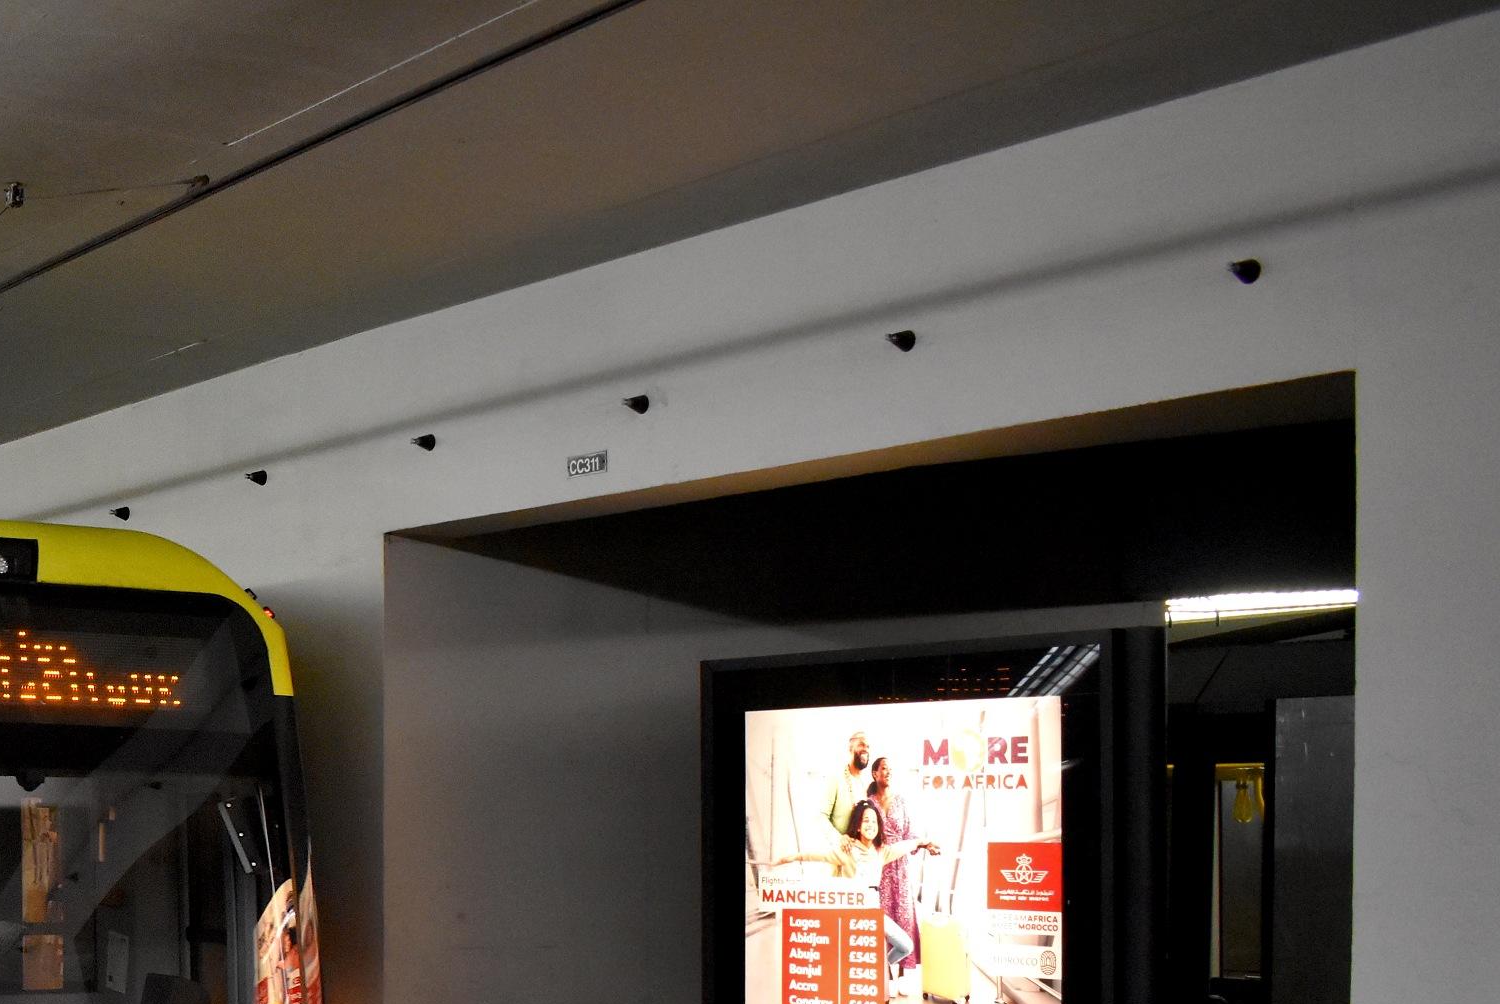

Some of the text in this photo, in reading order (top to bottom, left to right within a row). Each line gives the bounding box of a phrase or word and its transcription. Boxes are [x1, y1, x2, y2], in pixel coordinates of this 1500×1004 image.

[569, 456, 600, 475] CC311
[922, 773, 1029, 790] FOR AFRICA
[762, 889, 865, 906] MANCHESTER
[789, 916, 878, 932] Lagos £495
[789, 931, 878, 948] Abidjan £495
[789, 947, 821, 963] Abuja
[788, 963, 822, 979] Banjul
[788, 979, 819, 993] Accra
